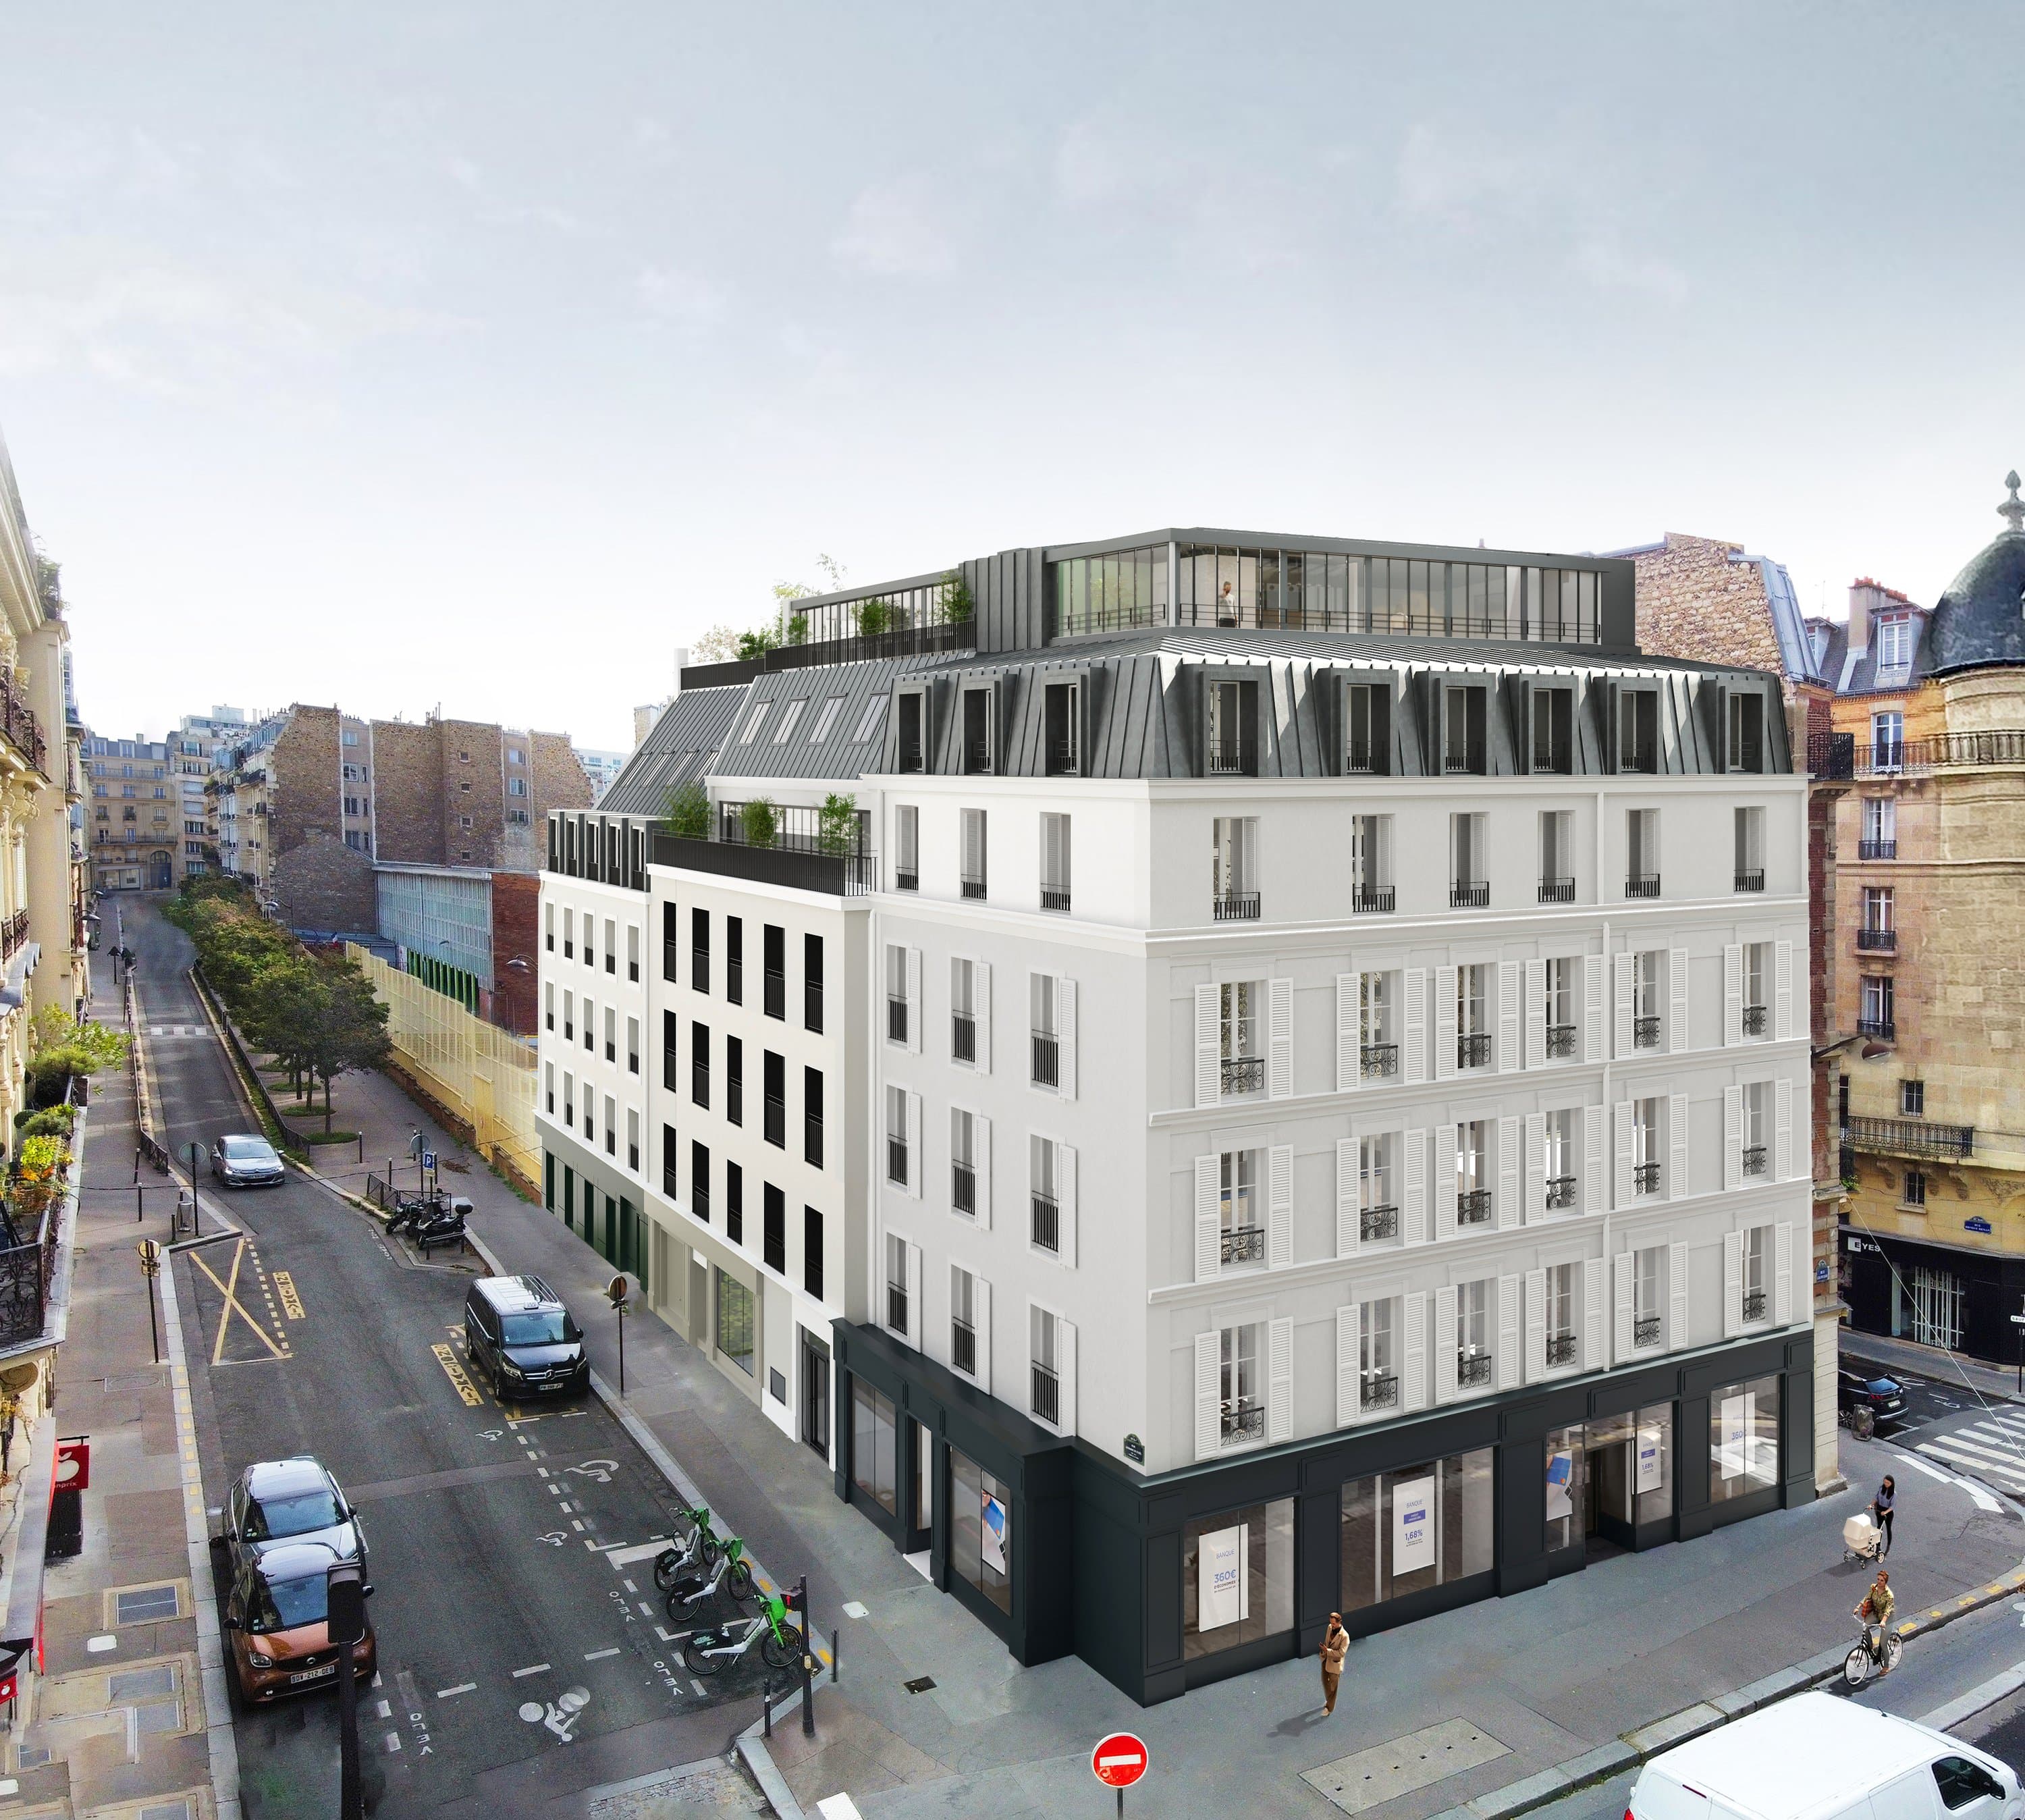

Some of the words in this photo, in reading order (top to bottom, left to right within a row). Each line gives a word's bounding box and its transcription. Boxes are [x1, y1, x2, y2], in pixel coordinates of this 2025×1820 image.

[1854, 1241, 1881, 1252] EYES
[55, 1480, 77, 1489] nprix
[1406, 1499, 1423, 1509] BANQUE
[1405, 1529, 1423, 1541] 1,68%
[1216, 1549, 1235, 1559] BANQUE
[1214, 1569, 1237, 1584] 360€
